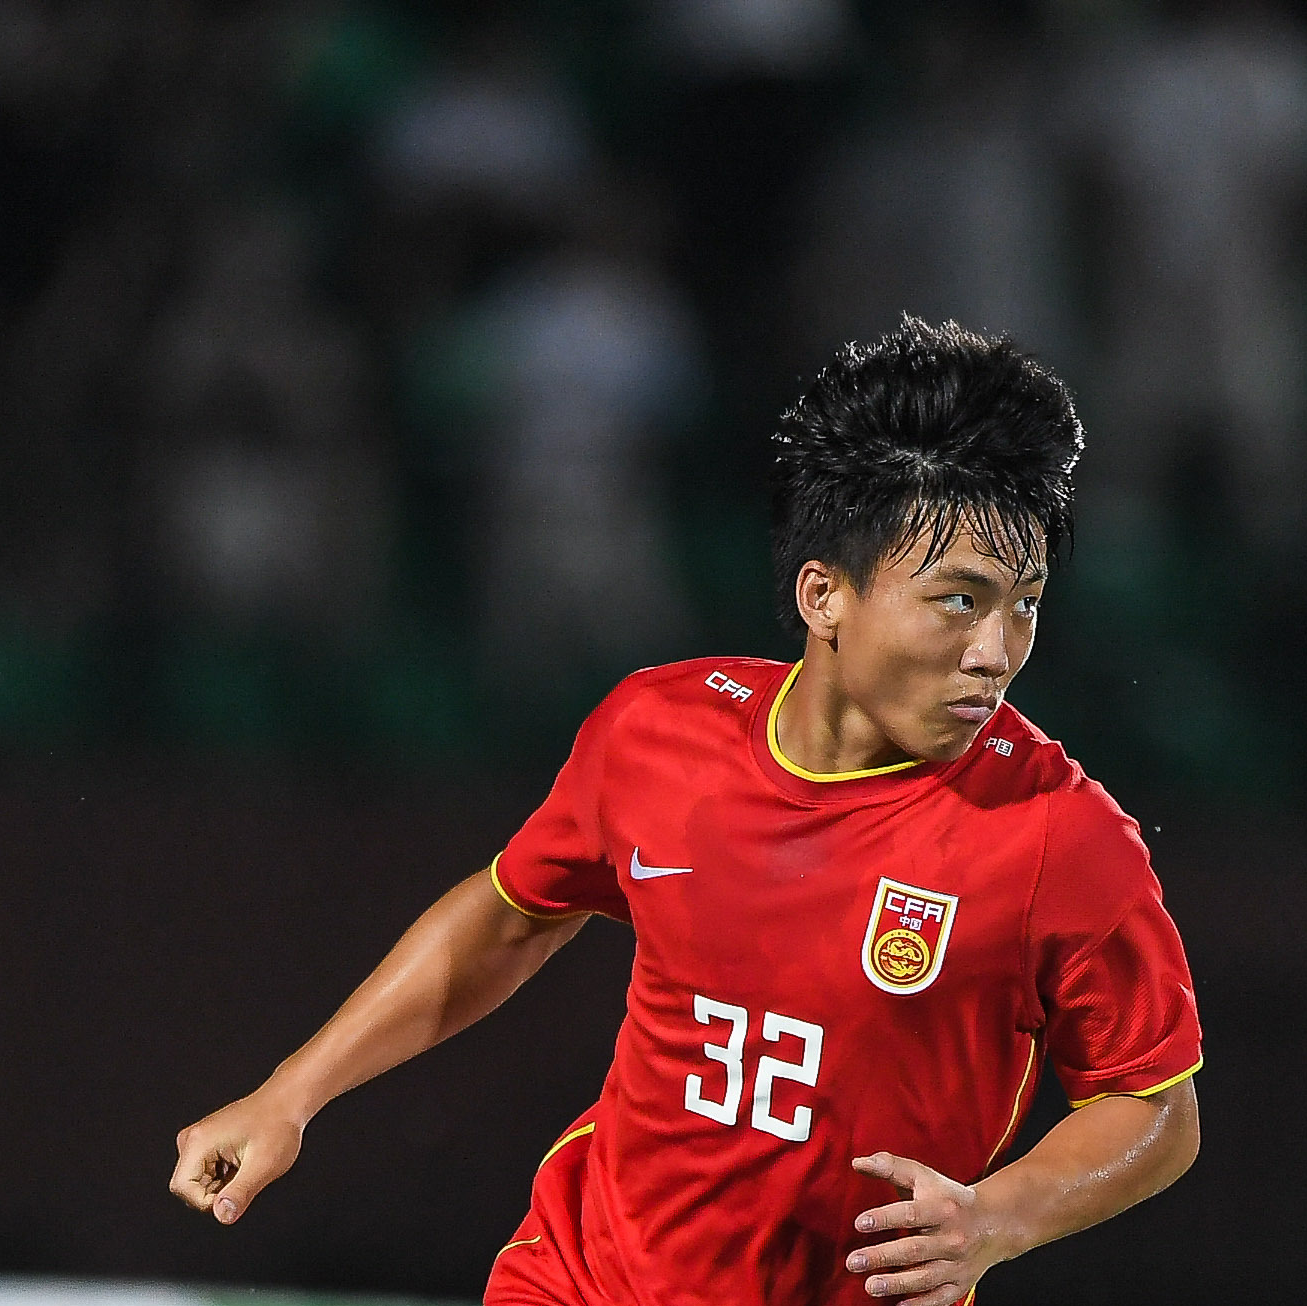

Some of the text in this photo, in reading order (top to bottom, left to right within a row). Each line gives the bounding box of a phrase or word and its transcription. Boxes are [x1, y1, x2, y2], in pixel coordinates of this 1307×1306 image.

[704, 670, 753, 703] CFA
[885, 891, 944, 923] CFA
[685, 994, 824, 1141] 32
